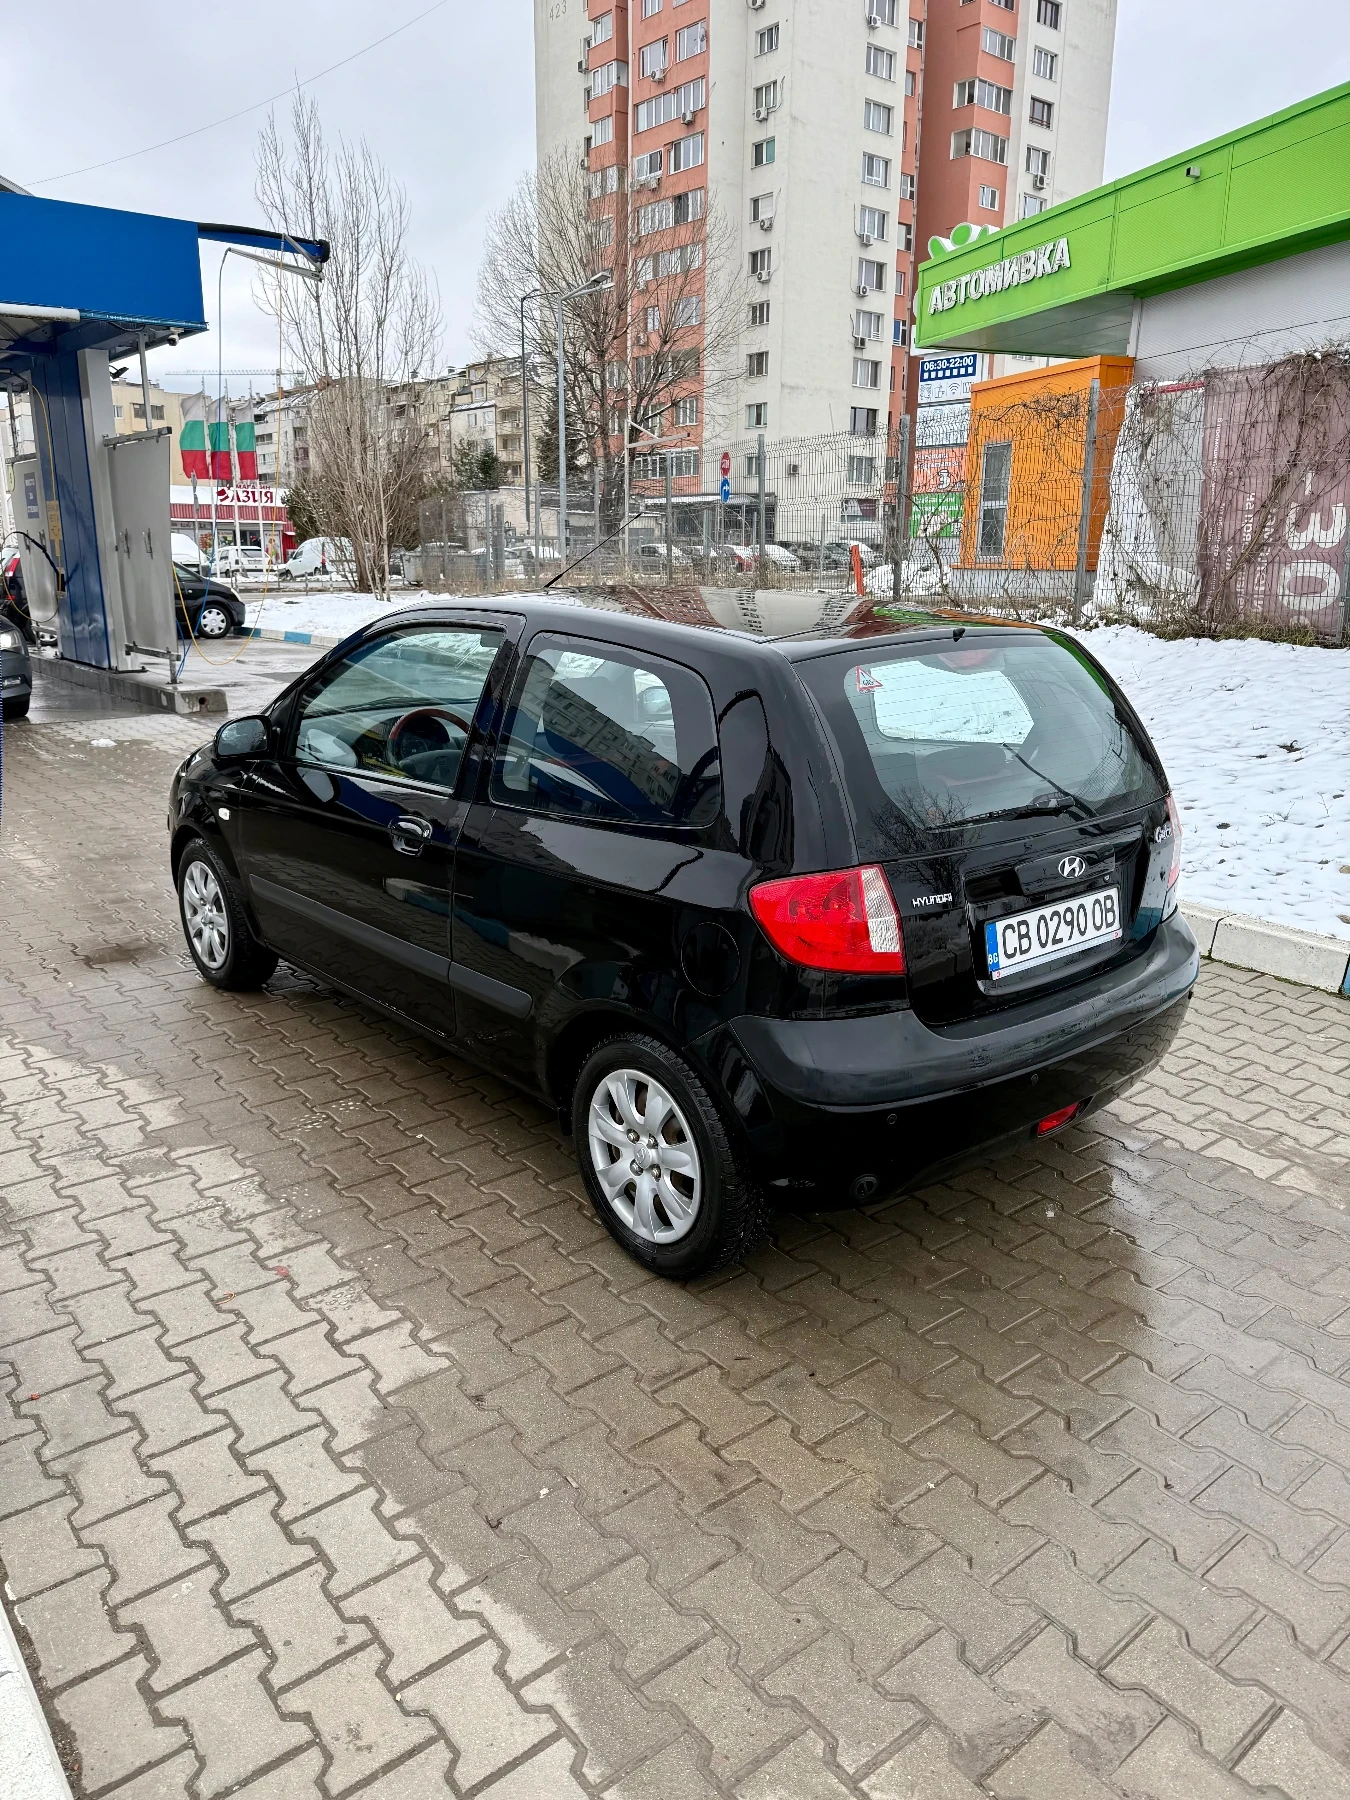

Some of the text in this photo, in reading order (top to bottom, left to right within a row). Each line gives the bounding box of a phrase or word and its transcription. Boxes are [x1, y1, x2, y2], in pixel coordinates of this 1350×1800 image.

[550, 0, 566, 21] 423
[928, 237, 1071, 315] АВТОМИВКА
[923, 356, 974, 371] 06:30-22:00
[230, 490, 273, 503] АЗИЯ
[911, 893, 952, 908] HYUNDAI
[1002, 894, 1117, 959] CB 0290 OB
[989, 952, 998, 964] BG
